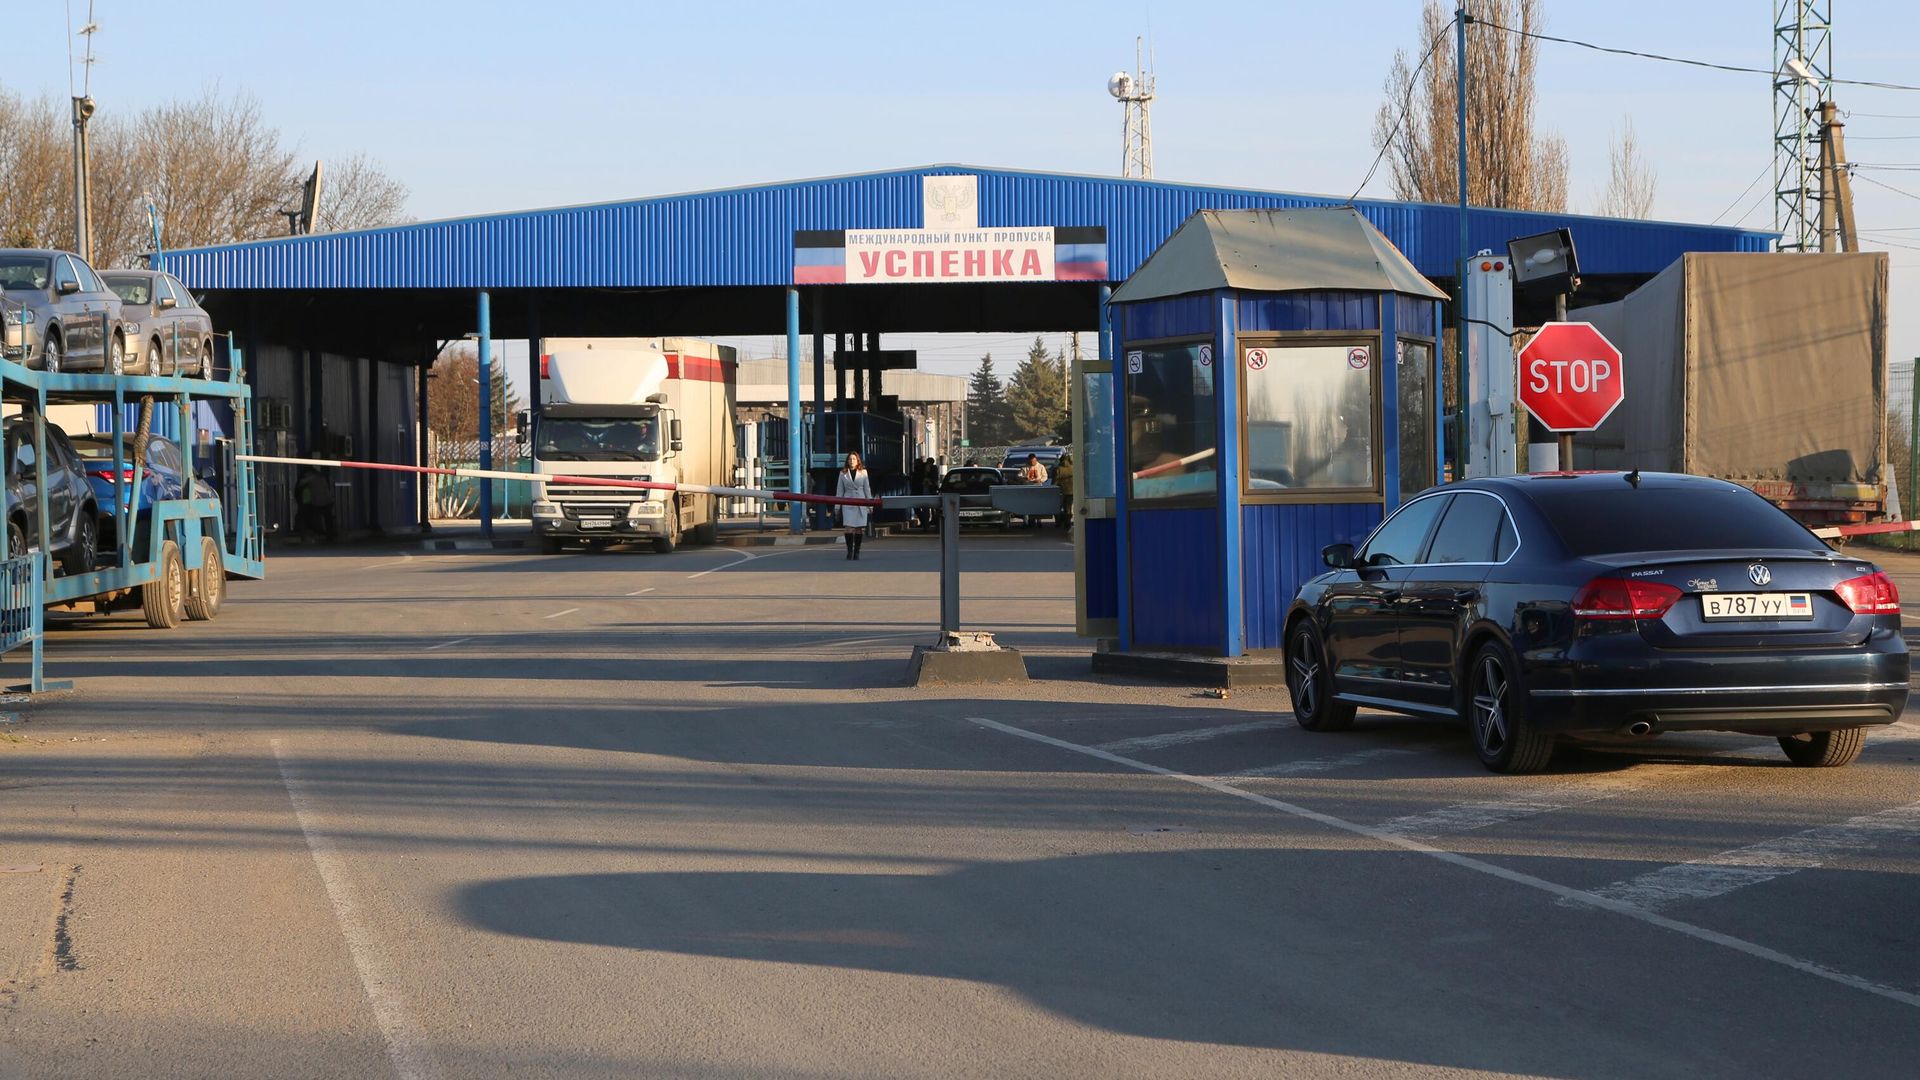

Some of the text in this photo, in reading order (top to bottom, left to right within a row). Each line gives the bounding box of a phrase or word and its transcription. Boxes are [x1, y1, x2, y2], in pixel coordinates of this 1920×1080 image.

[848, 231, 1052, 246] МЕЖДУНАРОДНЫЙ ПУНКТ ПРОПУСКА
[859, 249, 1042, 278] УСПЕНКА
[1530, 359, 1611, 394] STOP
[1631, 569, 1665, 577] PASSAT
